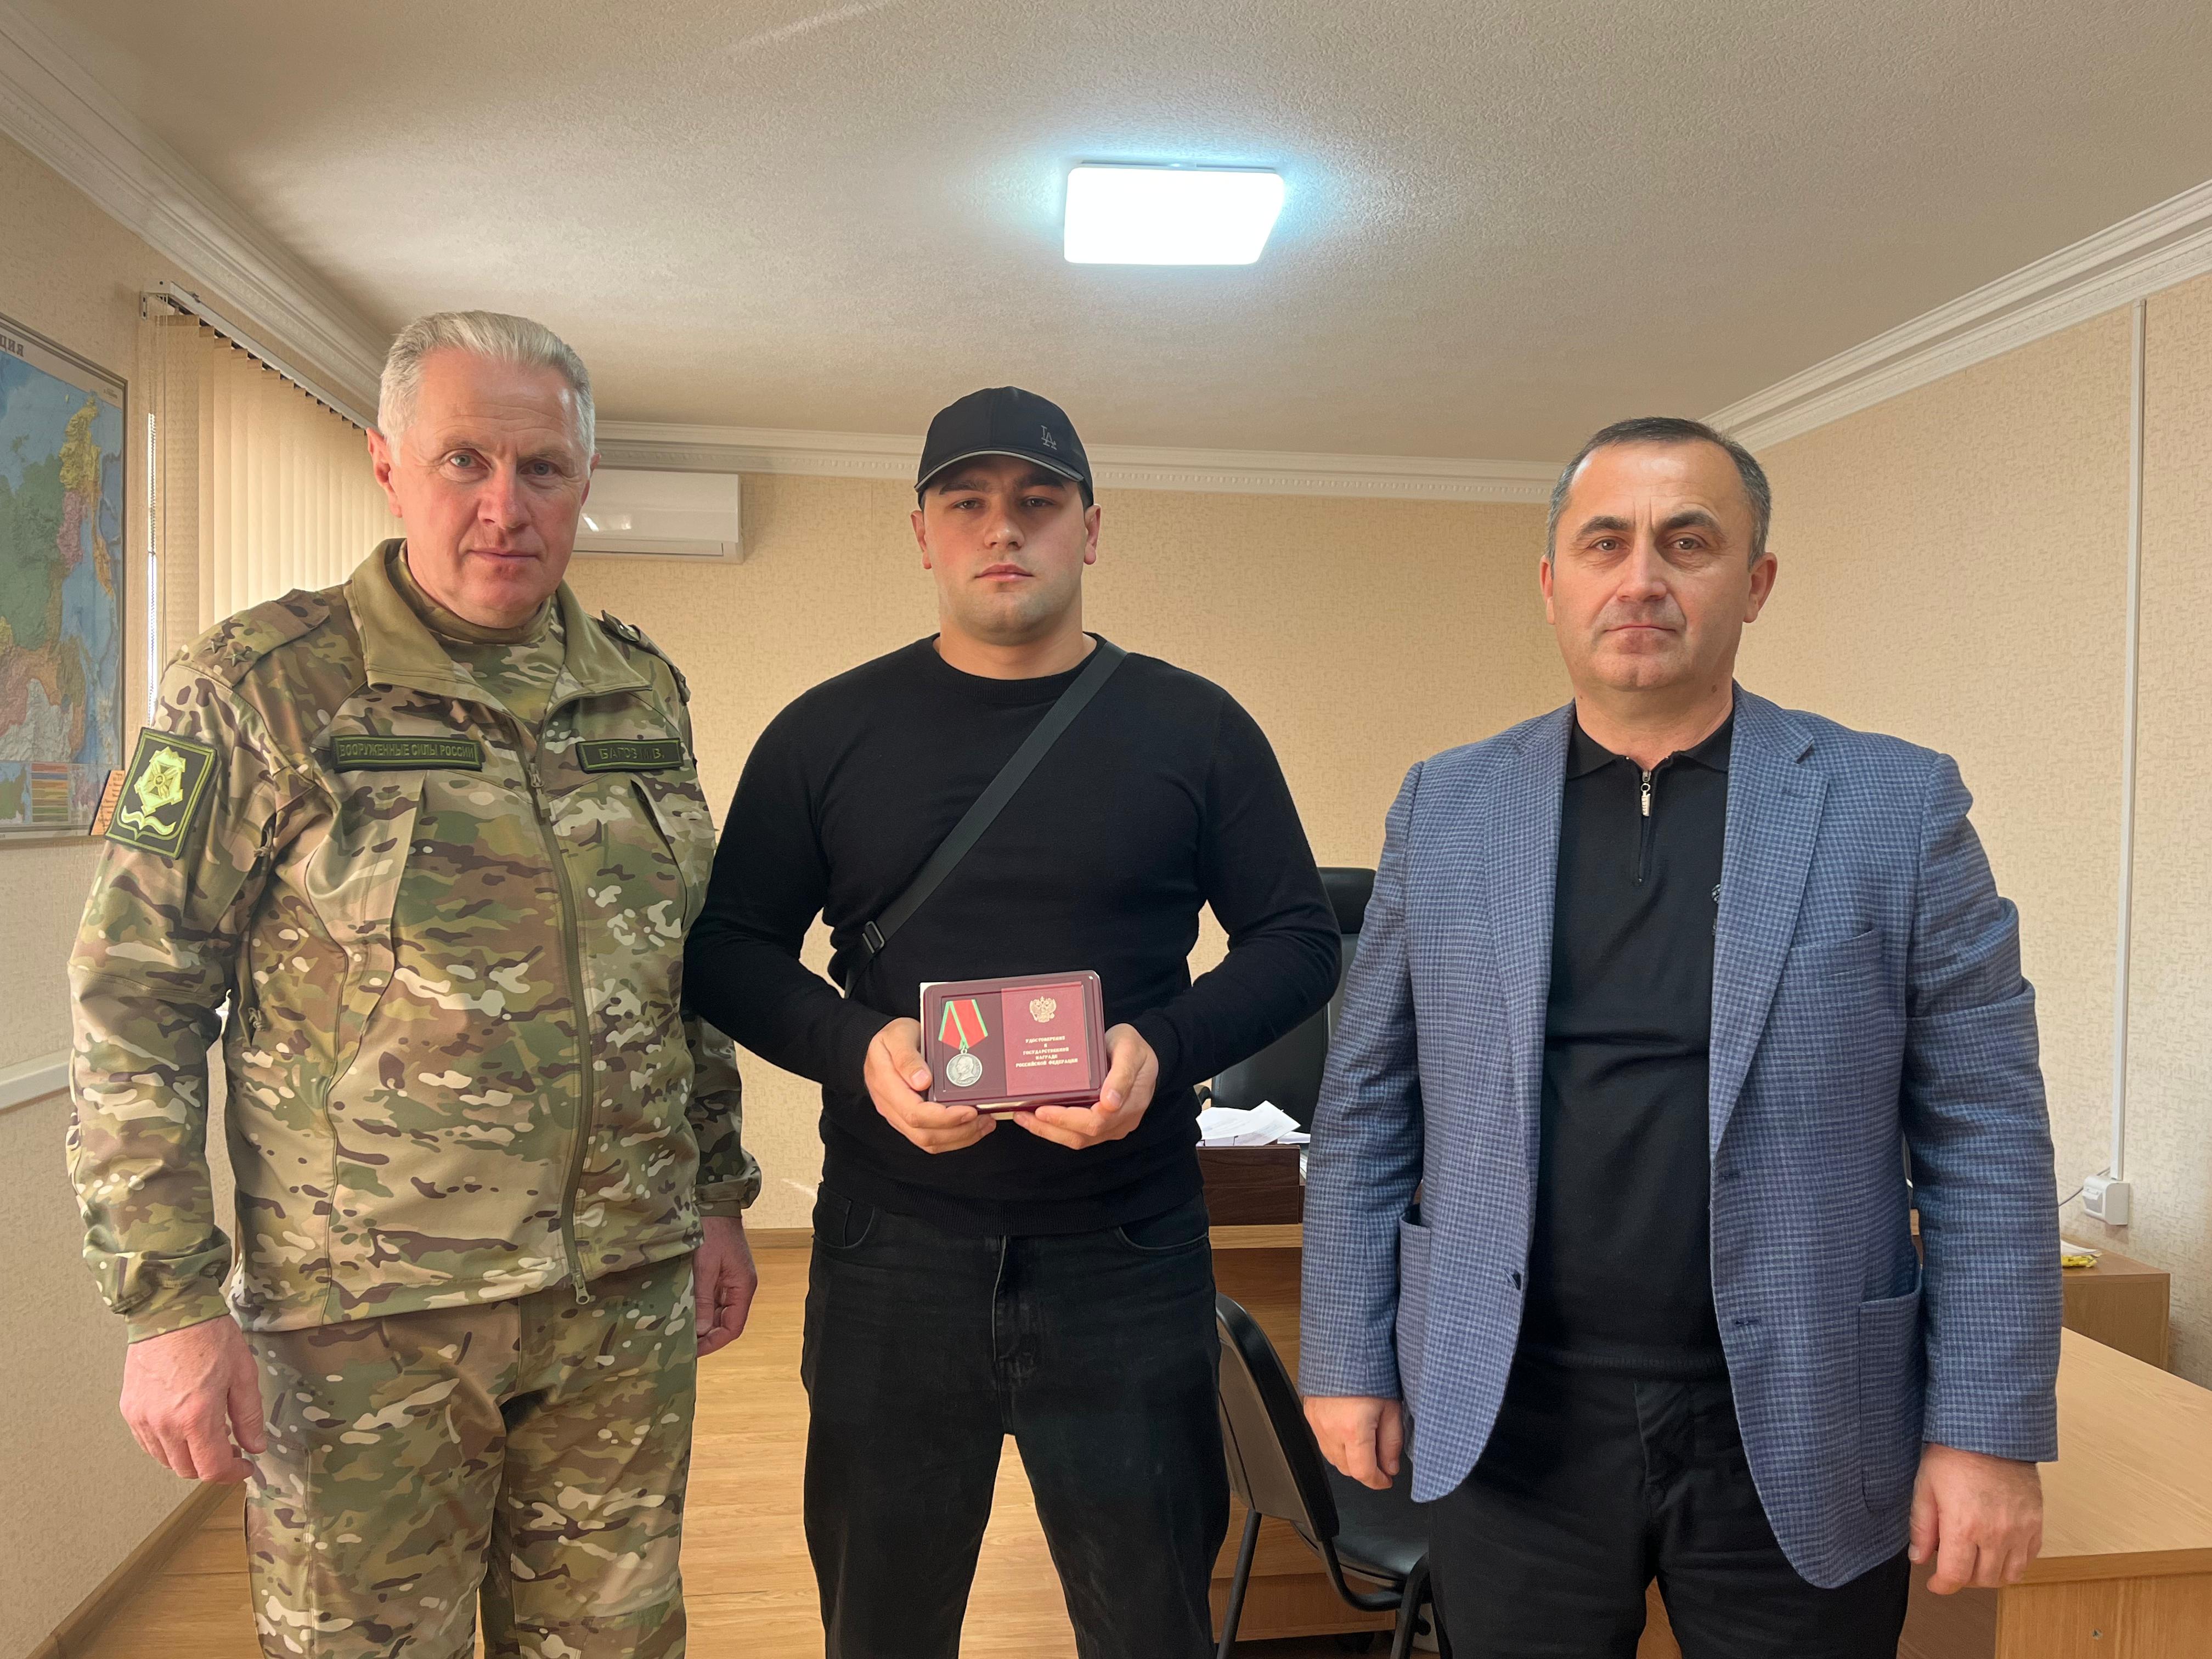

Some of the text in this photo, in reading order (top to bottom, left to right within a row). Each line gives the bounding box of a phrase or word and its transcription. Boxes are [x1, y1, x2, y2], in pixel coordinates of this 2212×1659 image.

[1040, 425, 1057, 450] LA
[339, 743, 474, 758] ВООРУЖЕННЫЕ СИЛЫ РОССИИ
[1023, 1047, 1069, 1055] ГОСУДАРСТВЕННОЙ
